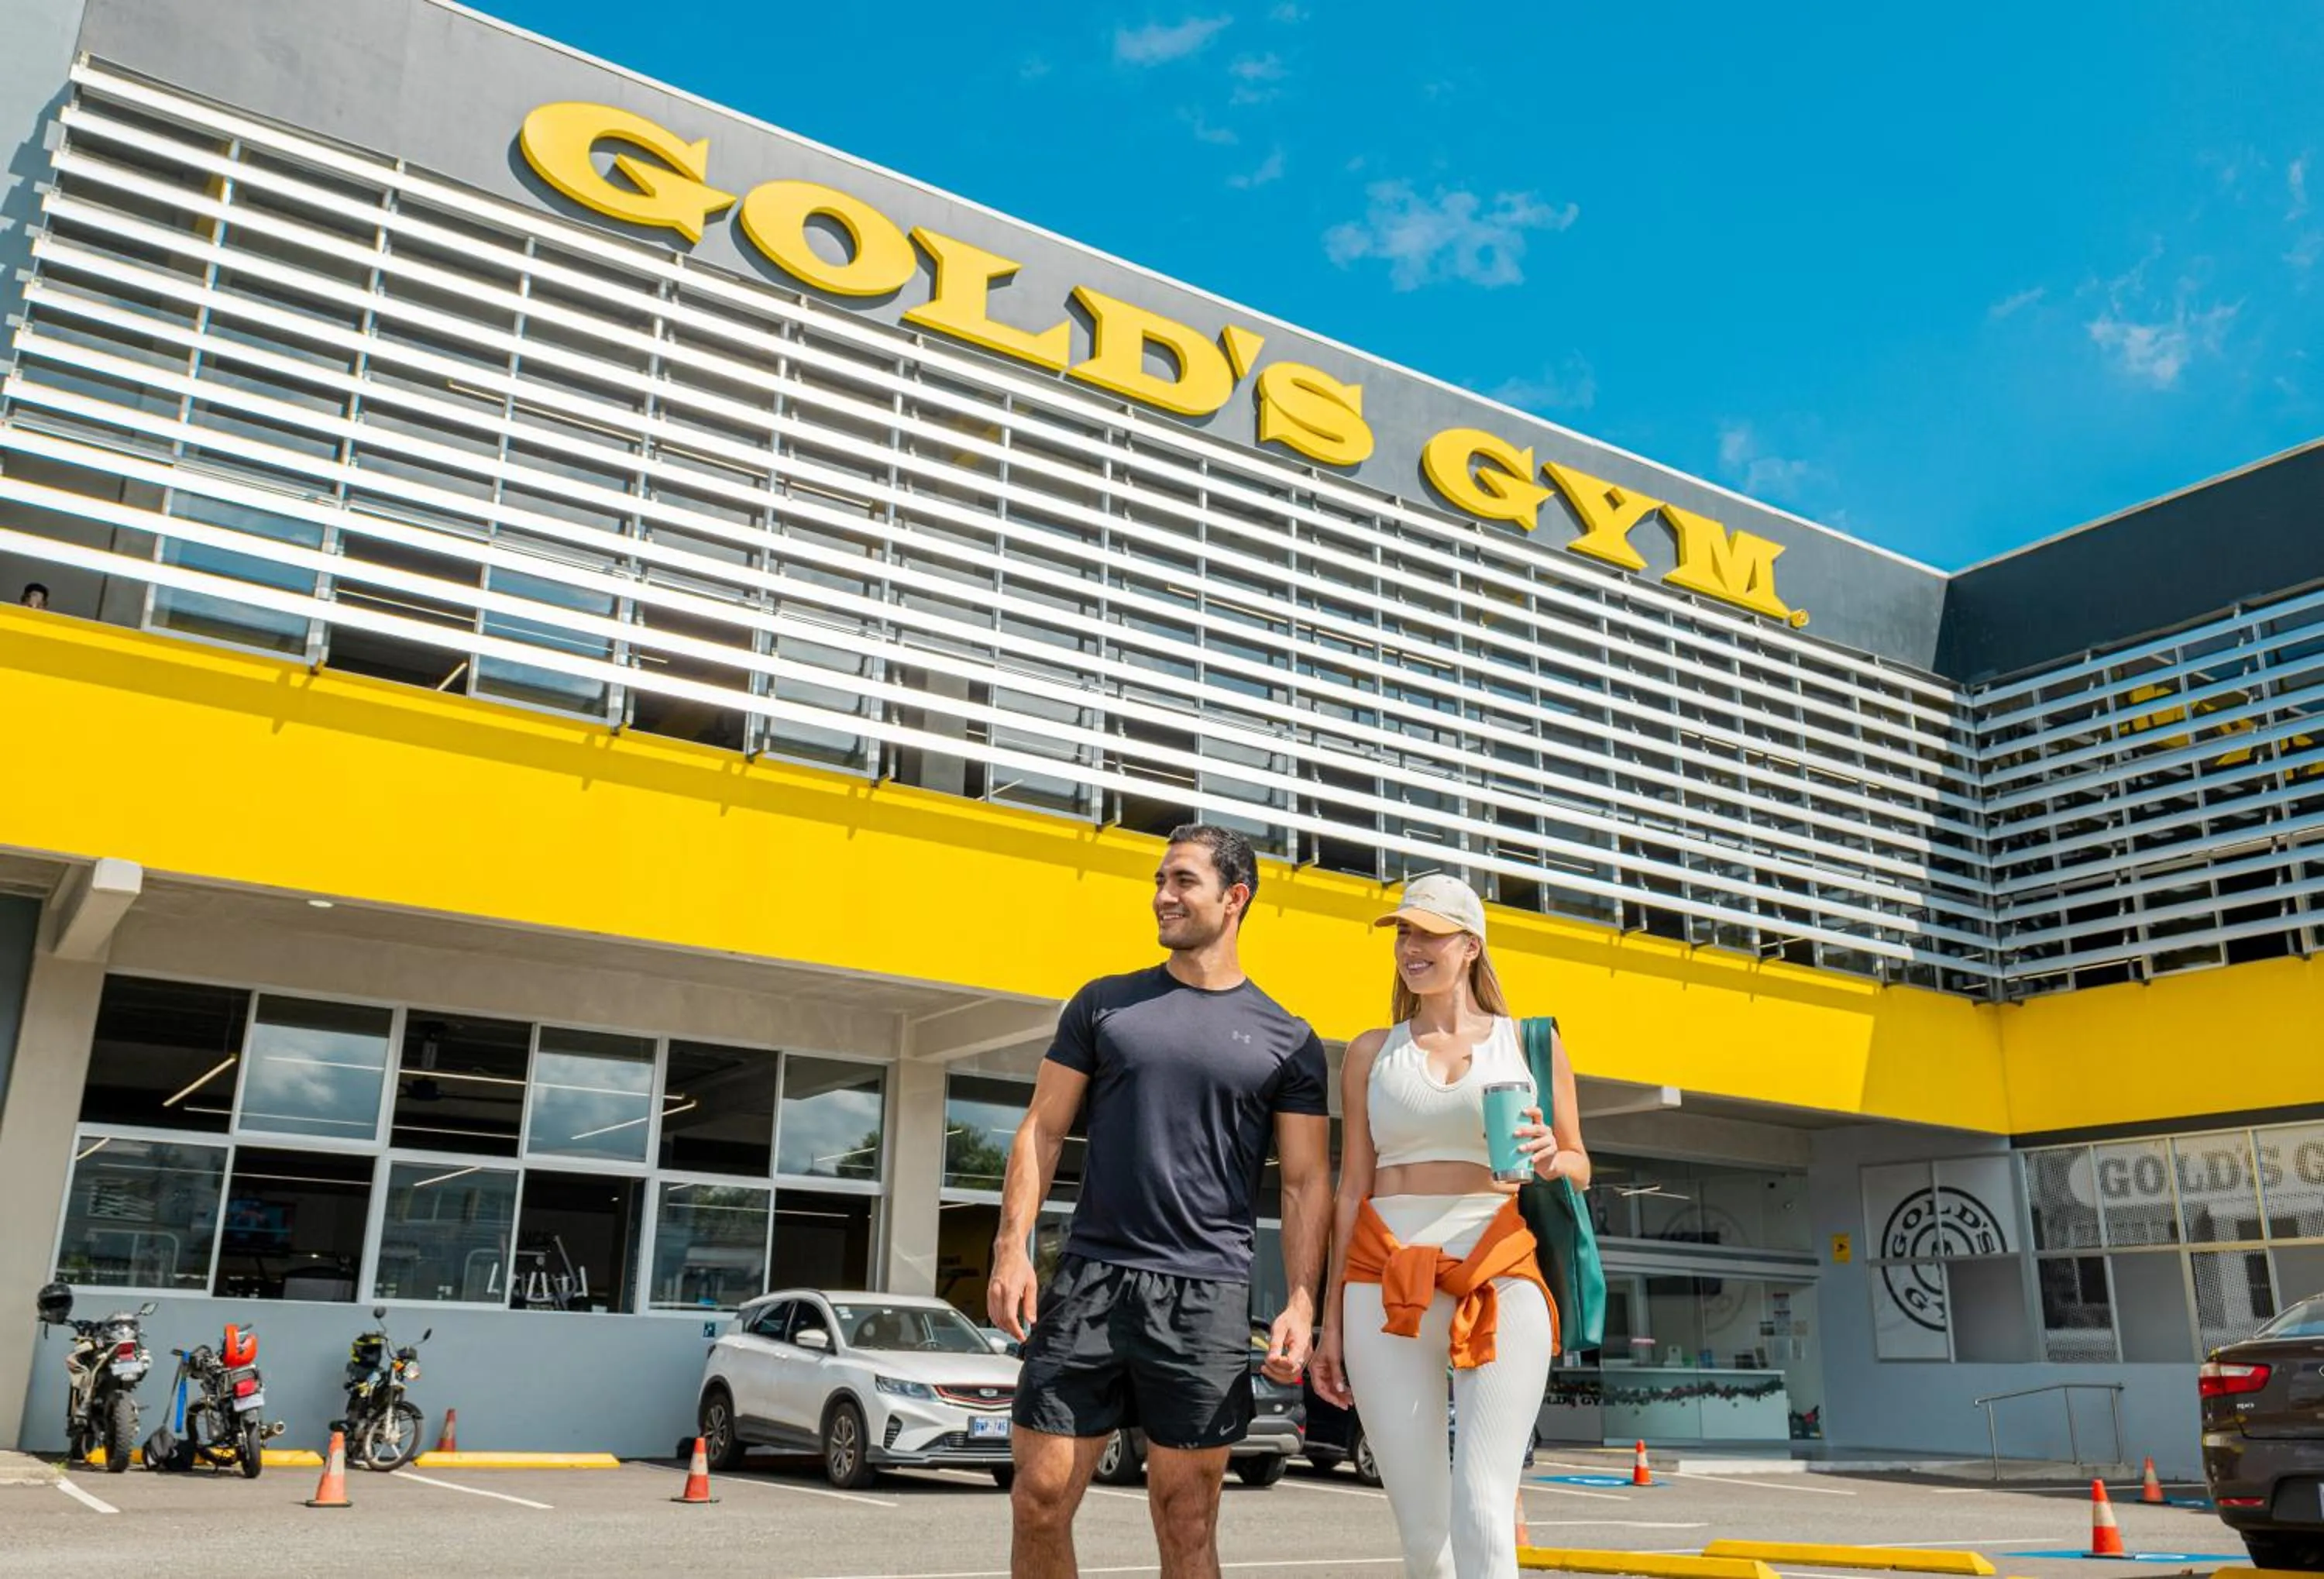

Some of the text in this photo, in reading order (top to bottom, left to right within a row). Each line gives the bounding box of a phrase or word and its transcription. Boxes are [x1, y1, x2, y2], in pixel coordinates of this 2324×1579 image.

[520, 101, 1791, 619] GOLD'S GYM
[1892, 1200, 1996, 1258] GOLD'S
